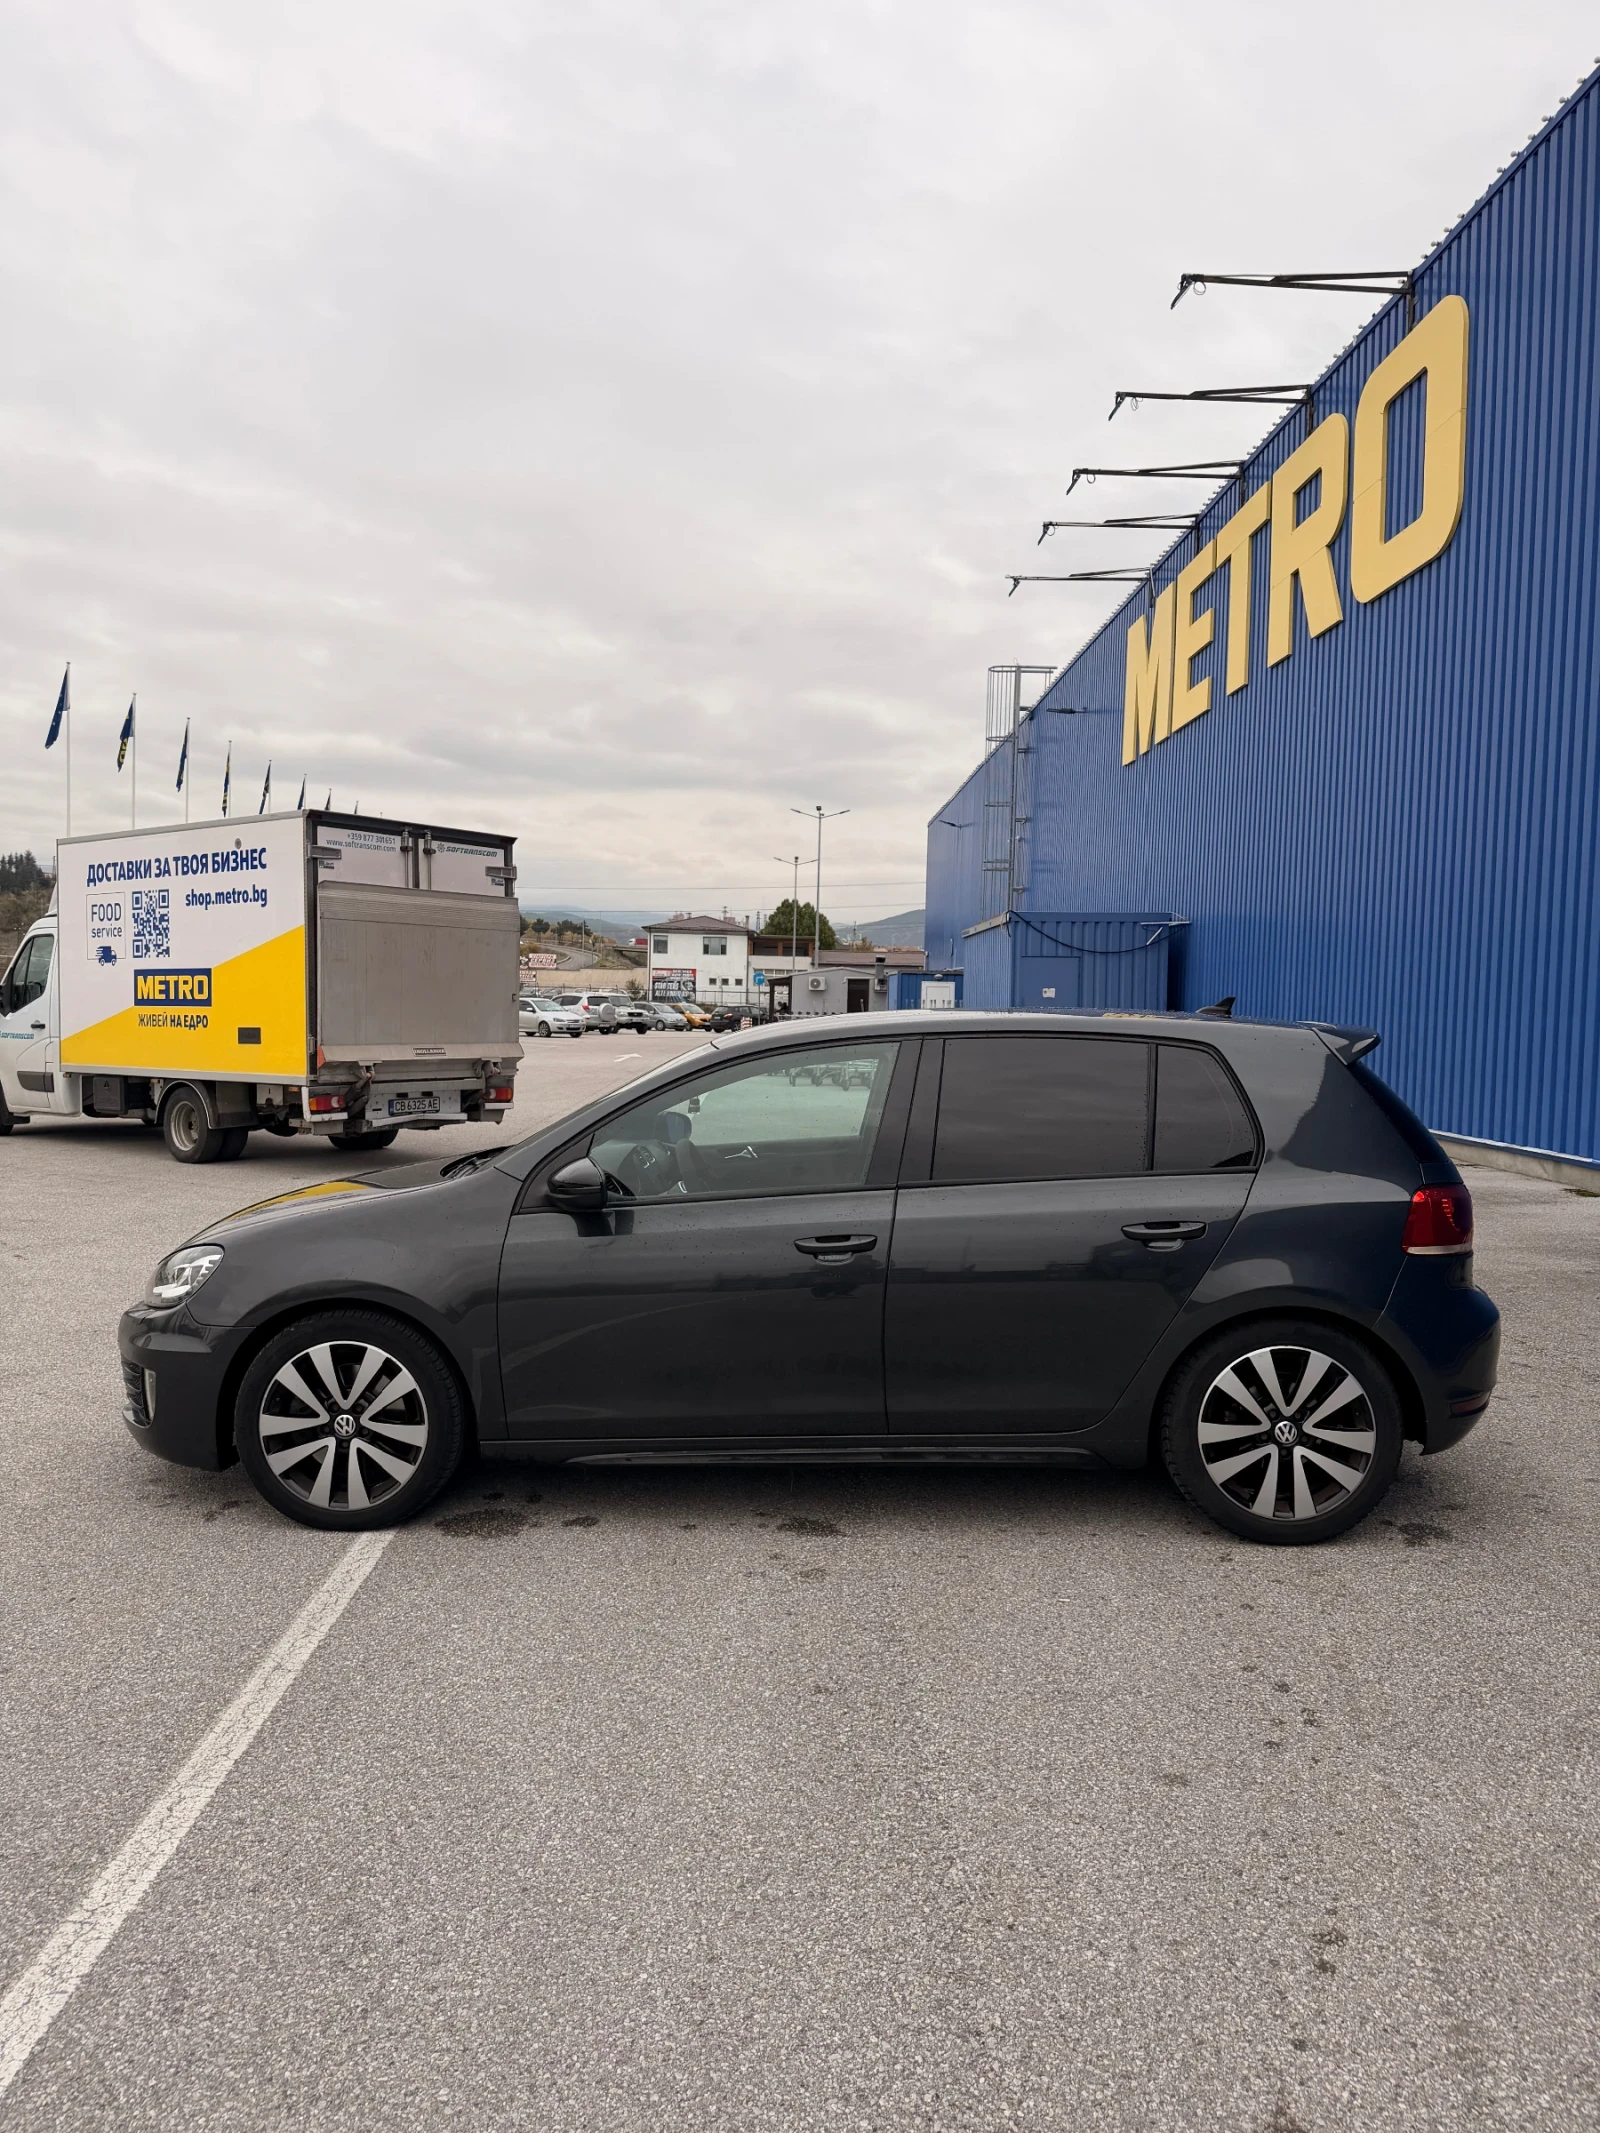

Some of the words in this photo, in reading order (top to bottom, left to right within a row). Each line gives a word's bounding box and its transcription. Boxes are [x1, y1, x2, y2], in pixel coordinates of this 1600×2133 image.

[1122, 295, 1469, 766] METRO
[326, 839, 397, 853] www.softranscom.com
[363, 834, 374, 842] 877
[446, 846, 498, 857] SOFTRANSCOM
[87, 859, 152, 887] ДОСТАВКИ
[154, 857, 171, 878] ЗА
[173, 853, 209, 876] ТВОЯ
[211, 848, 267, 873] БИЗНЕС
[185, 884, 268, 910] shop.metro.bg
[91, 903, 122, 922] FOOD
[91, 923, 122, 938] service
[137, 975, 209, 1000] METRO
[138, 1012, 168, 1027] ЖИВЕЙ
[170, 1014, 182, 1028] НА
[183, 1014, 209, 1030] ЕДРО
[395, 1101, 406, 1111] CB
[407, 1100, 426, 1110] 6325
[428, 1098, 438, 1109] AE
